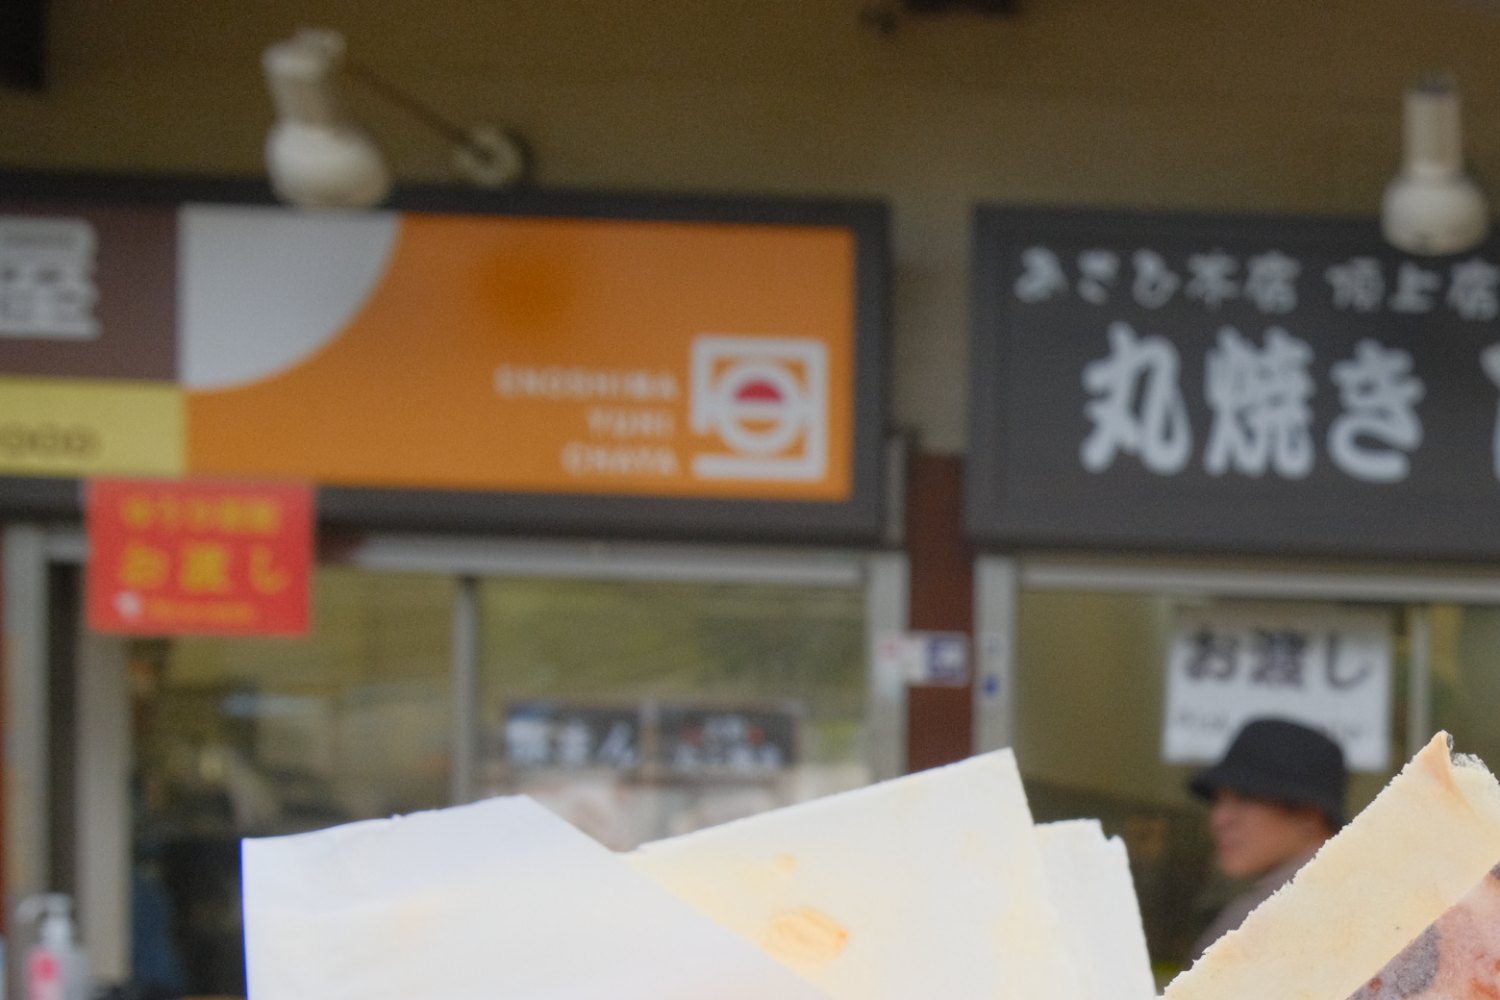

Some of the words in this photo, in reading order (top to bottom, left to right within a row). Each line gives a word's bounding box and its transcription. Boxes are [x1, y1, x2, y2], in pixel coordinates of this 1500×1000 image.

[494, 364, 680, 402] ENOSHIMA
[1079, 321, 1427, 484] 丸焼き
[560, 442, 680, 476] CHAYA
[1184, 625, 1374, 692] お渡し
